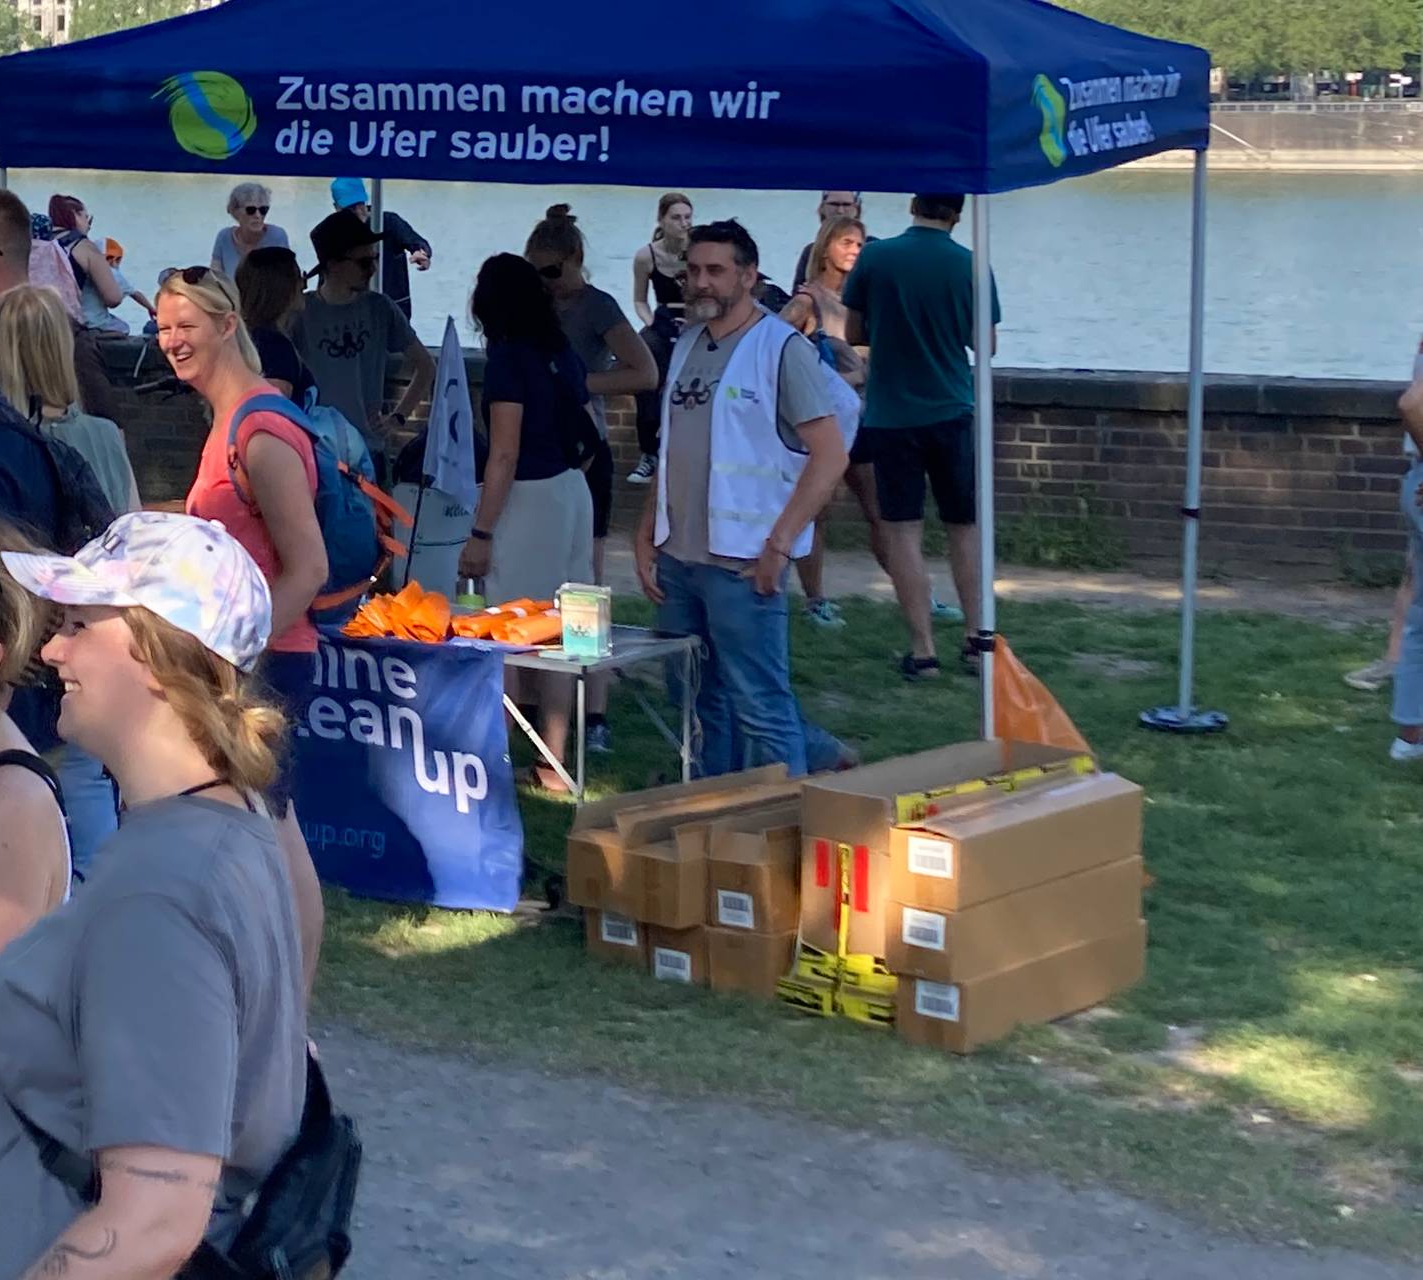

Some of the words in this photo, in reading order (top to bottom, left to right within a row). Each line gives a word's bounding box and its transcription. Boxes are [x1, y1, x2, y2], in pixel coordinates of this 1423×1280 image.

[275, 76, 506, 112] Zusammen
[521, 80, 693, 117] machen
[709, 81, 781, 119] wir
[275, 120, 334, 155] die
[348, 120, 437, 157] Ufer
[450, 124, 610, 162] sauber!
